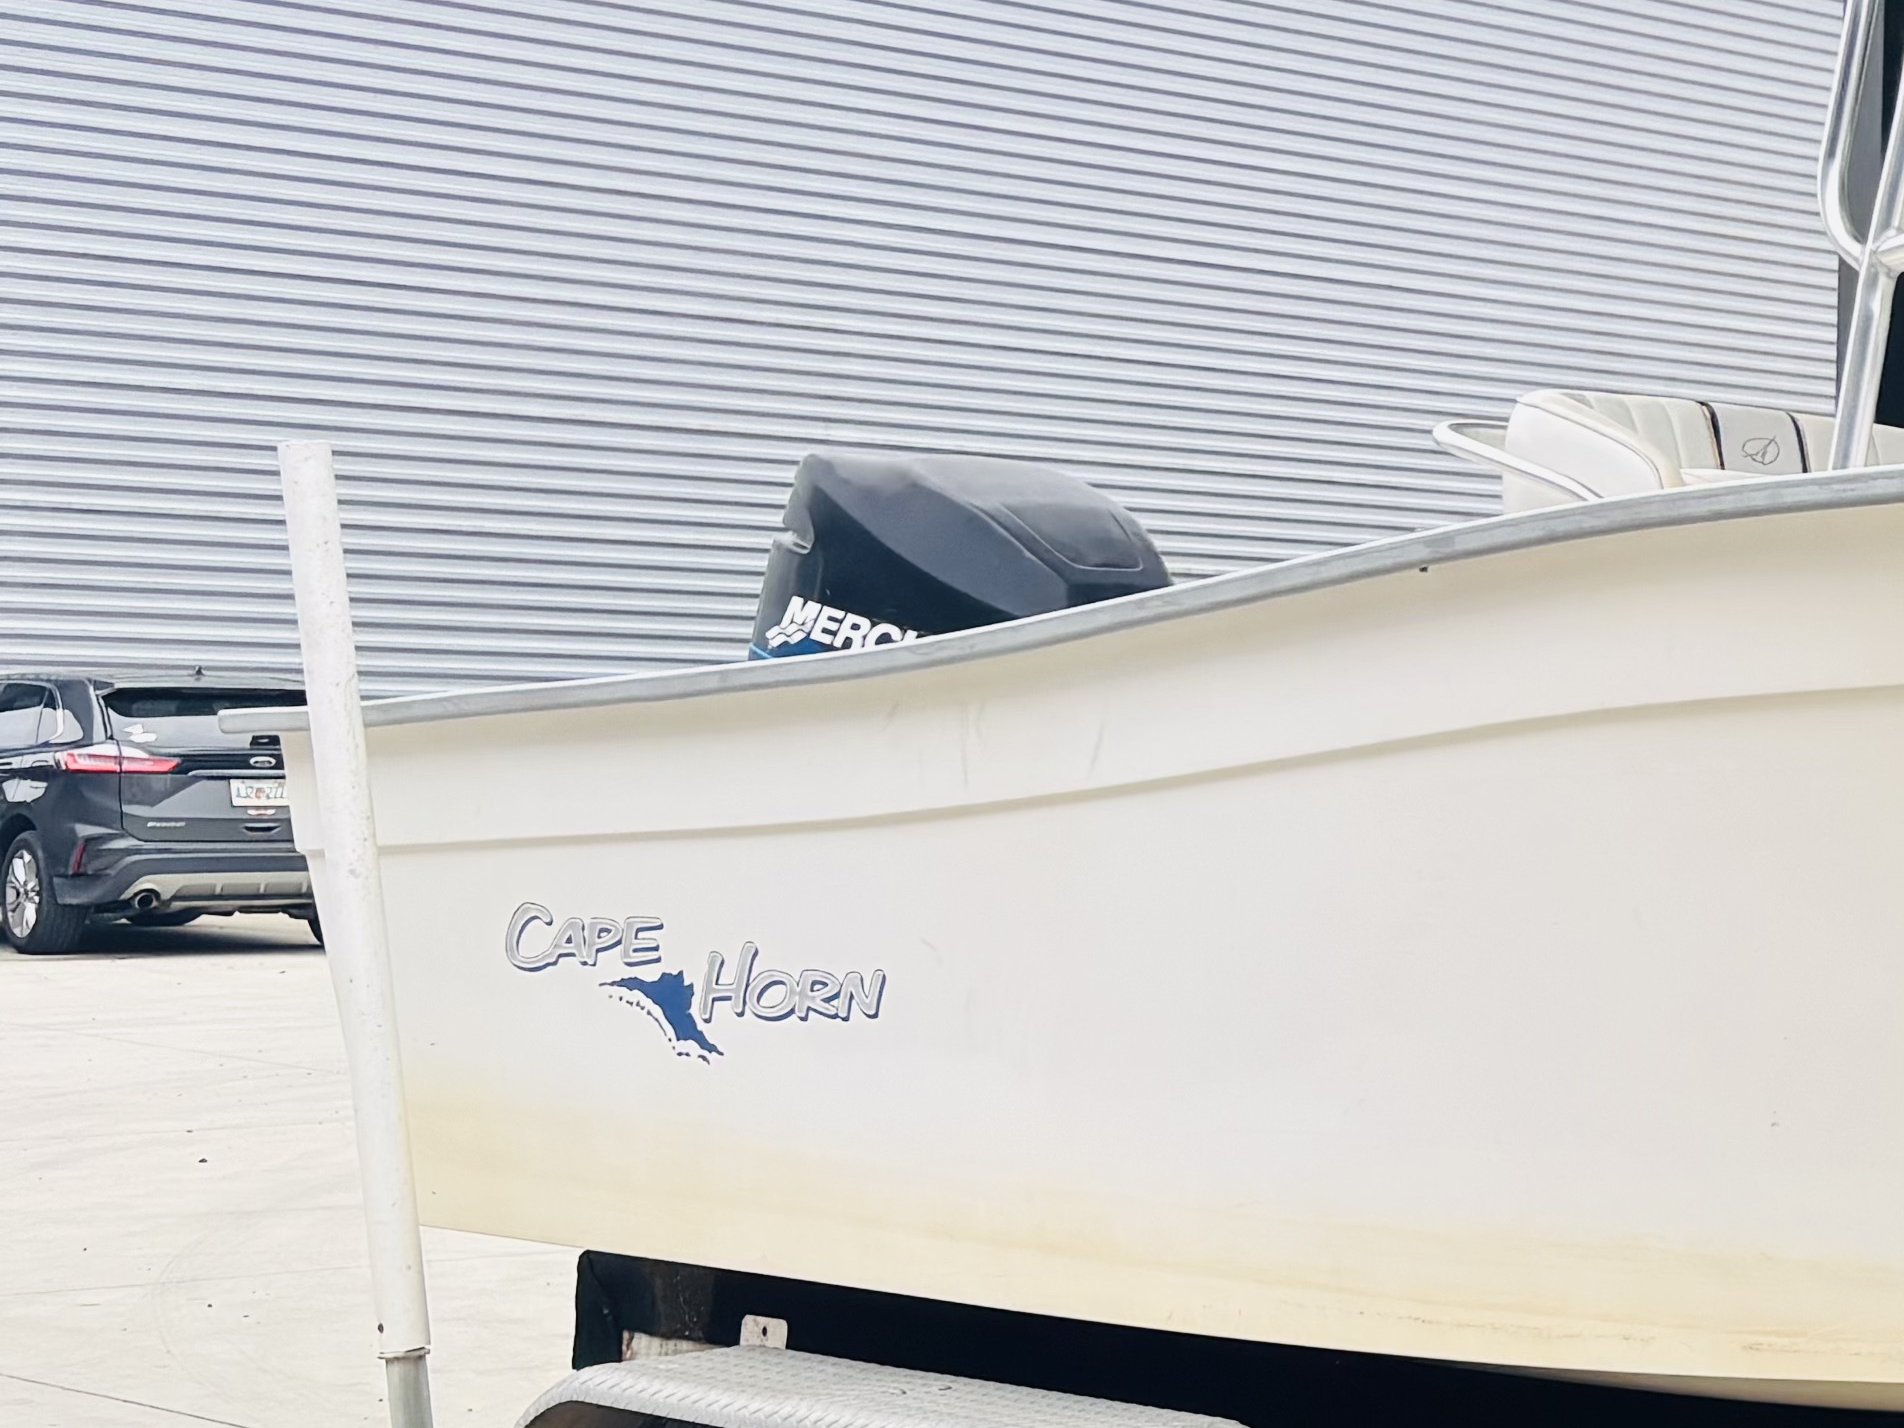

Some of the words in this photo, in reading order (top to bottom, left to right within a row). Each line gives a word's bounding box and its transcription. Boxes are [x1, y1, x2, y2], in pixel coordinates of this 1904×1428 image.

[776, 595, 918, 650] MERC
[505, 901, 664, 972] CAPE
[700, 941, 885, 1023] HORN
